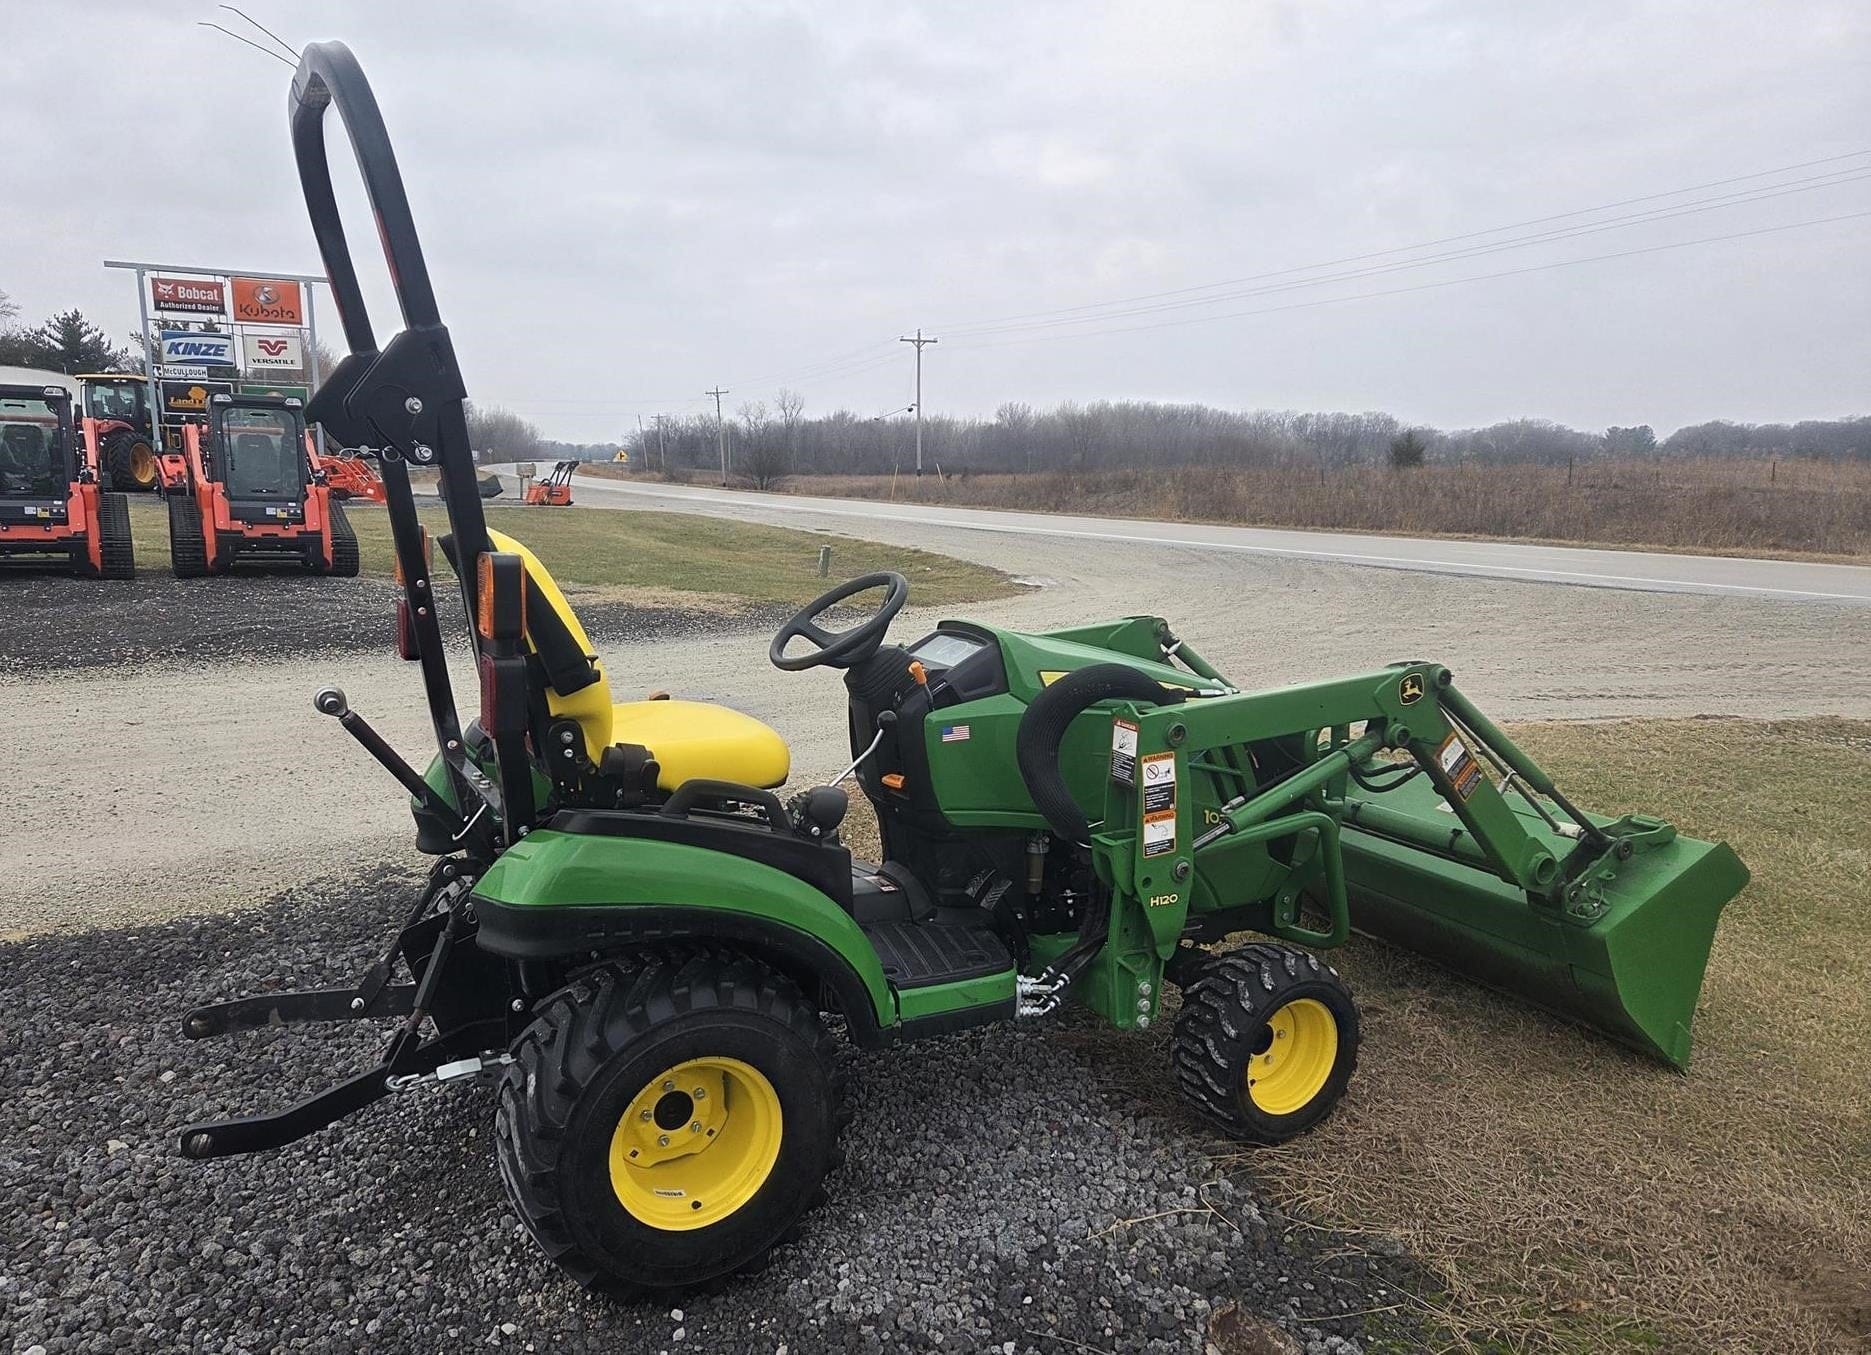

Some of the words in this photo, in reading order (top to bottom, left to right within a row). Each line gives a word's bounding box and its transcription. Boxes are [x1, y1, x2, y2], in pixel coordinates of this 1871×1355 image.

[178, 285, 219, 301] Bobcat
[160, 301, 196, 310] Authorized
[197, 303, 219, 312] Dealer
[239, 303, 295, 319] Kubota
[166, 341, 228, 357] KINZE
[1150, 893, 1178, 907] H120
